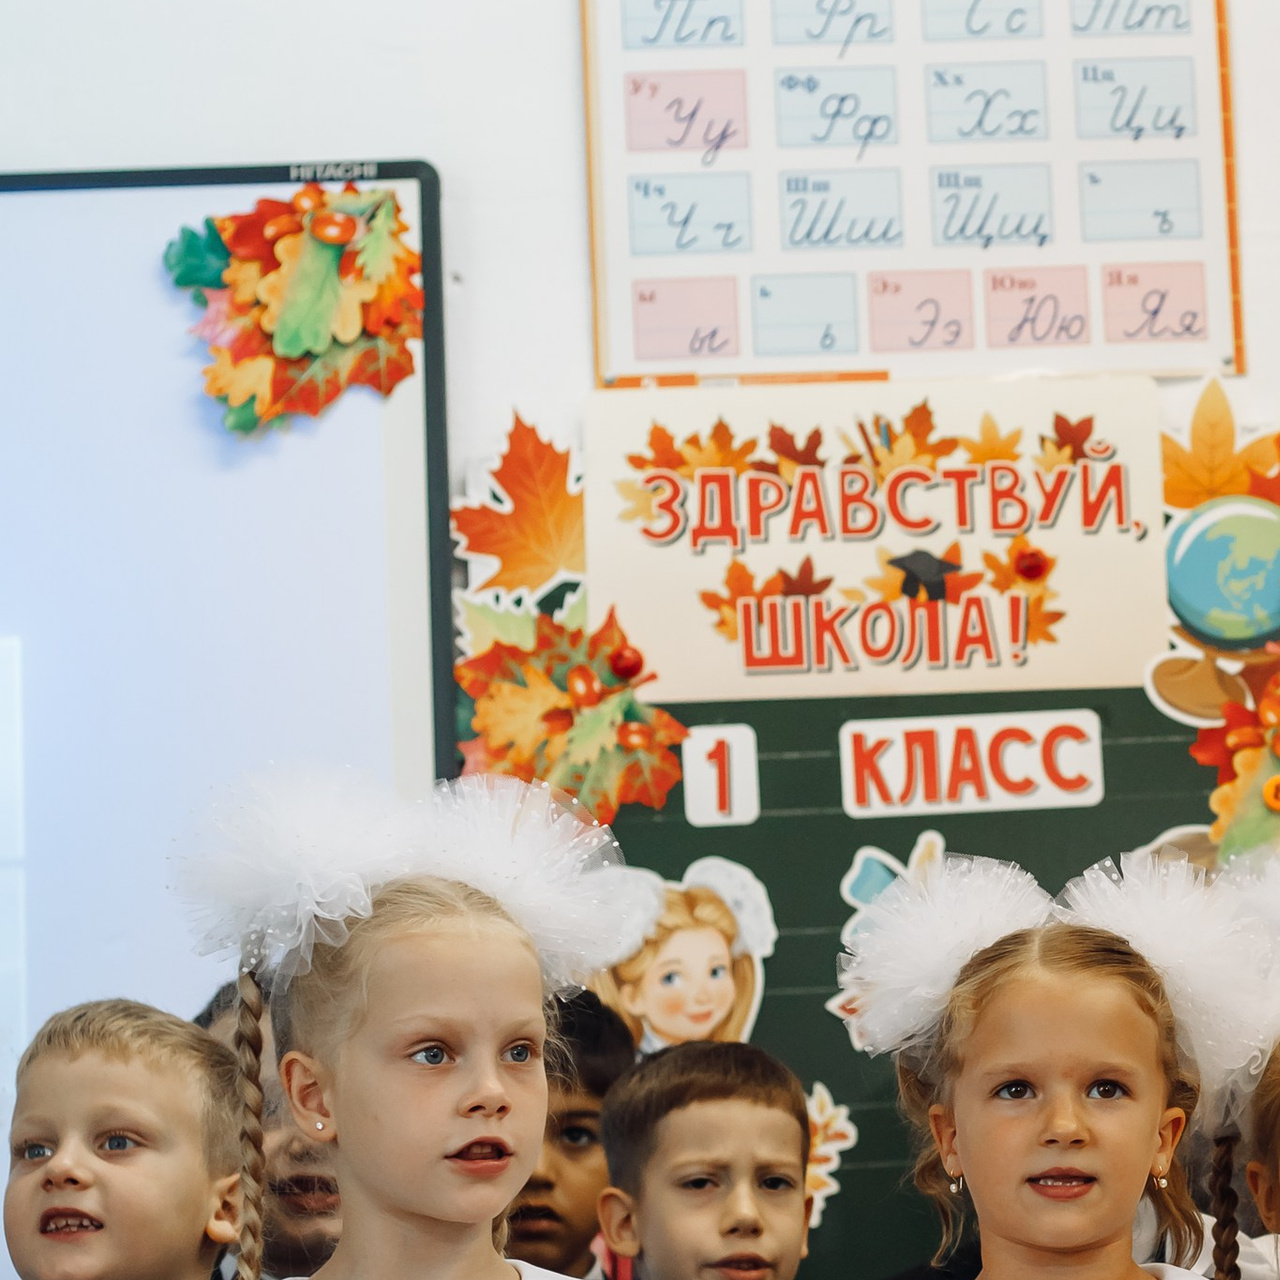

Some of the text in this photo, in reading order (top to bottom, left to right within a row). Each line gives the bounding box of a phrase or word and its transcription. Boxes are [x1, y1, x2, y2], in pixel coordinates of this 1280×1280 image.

[665, 86, 1185, 166] Уу Фф Хх Цц
[290, 162, 377, 180] HITACHI
[661, 192, 1174, 250] Чч Шш Щщ ъ
[689, 327, 729, 355] ы
[909, 298, 961, 347] Ээ
[1008, 294, 1085, 342] Юю
[1123, 289, 1202, 337] Яя
[639, 440, 1148, 553] ЗДРАВСТВУЙ,
[737, 593, 1028, 675] ШКОЛА!
[706, 724, 1091, 816] 1 КЛАСС
